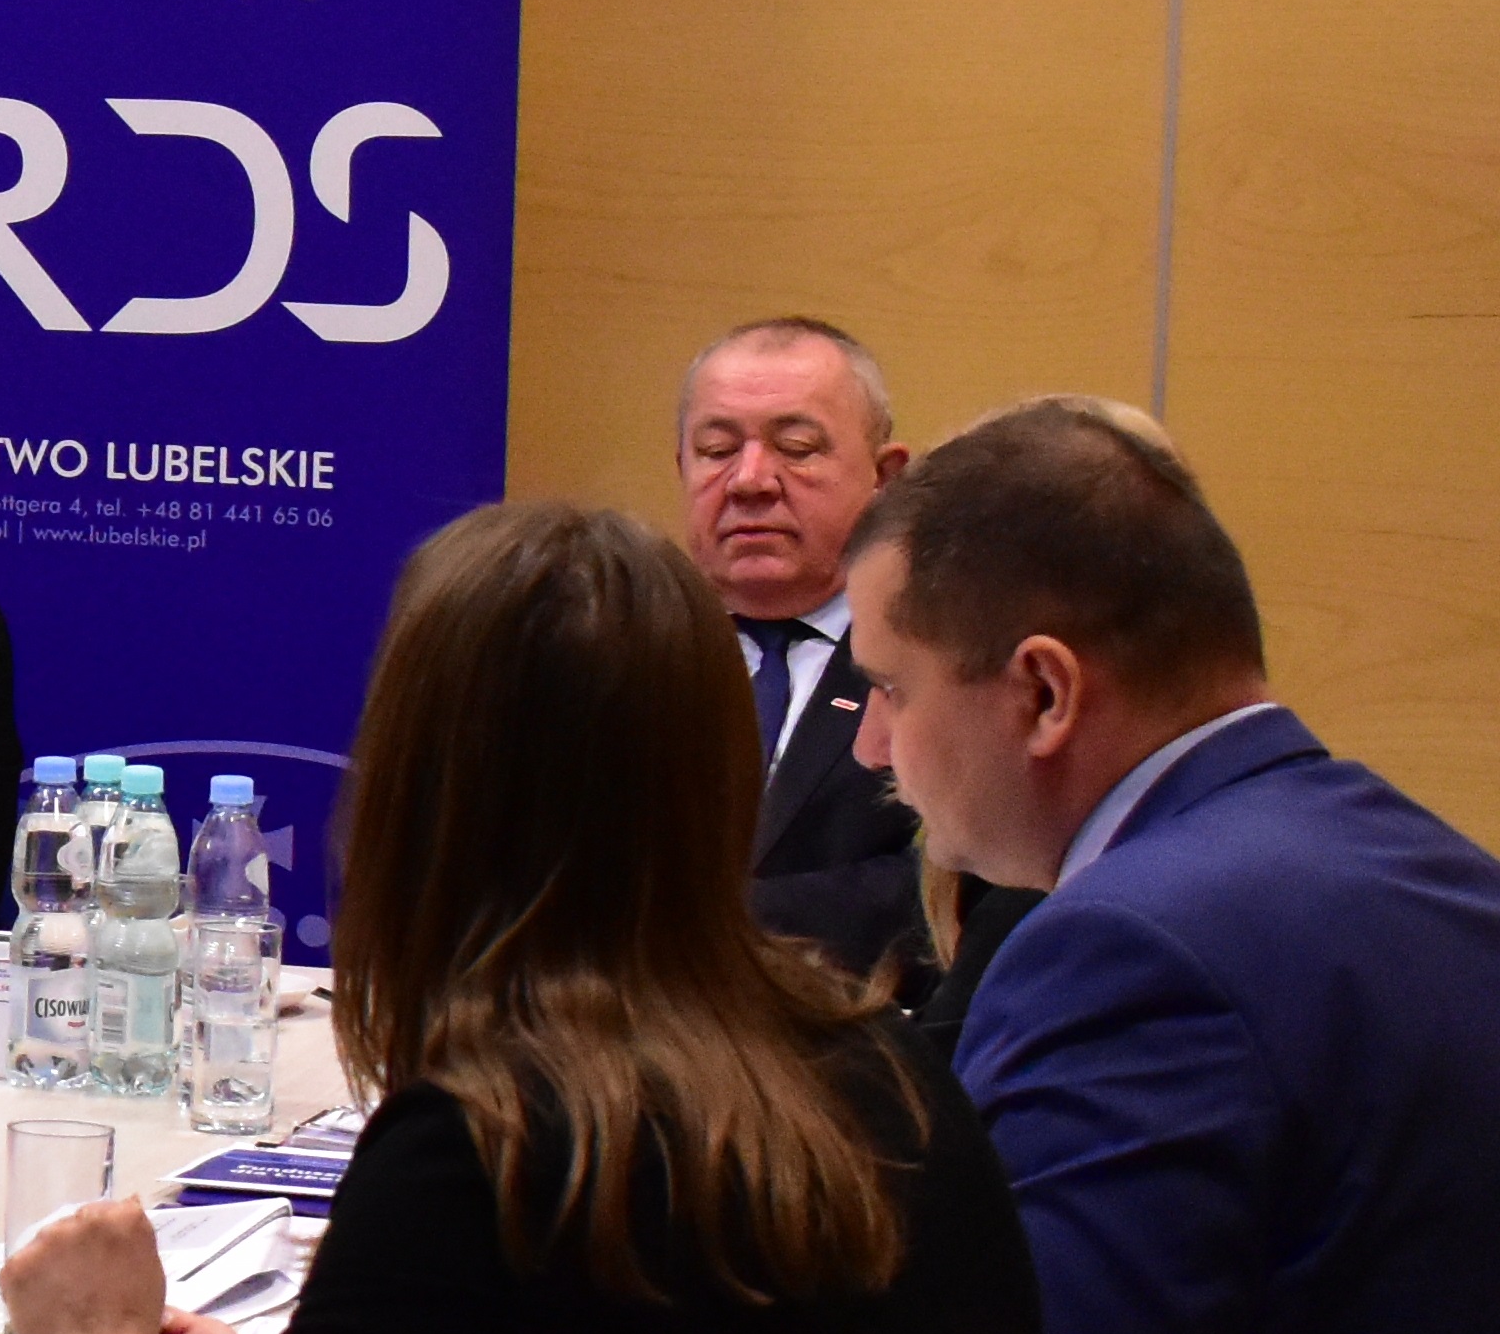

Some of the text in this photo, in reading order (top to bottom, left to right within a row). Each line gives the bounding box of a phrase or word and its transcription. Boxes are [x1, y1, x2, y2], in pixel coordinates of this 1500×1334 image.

[105, 441, 336, 491] LUBELSKIE
[96, 498, 127, 518] tel.
[136, 501, 182, 521] +48
[189, 502, 214, 521] 81
[224, 504, 262, 524] 441
[273, 506, 299, 526] 65
[306, 508, 334, 528] 06
[33, 527, 208, 553] www.lubelskie.pl
